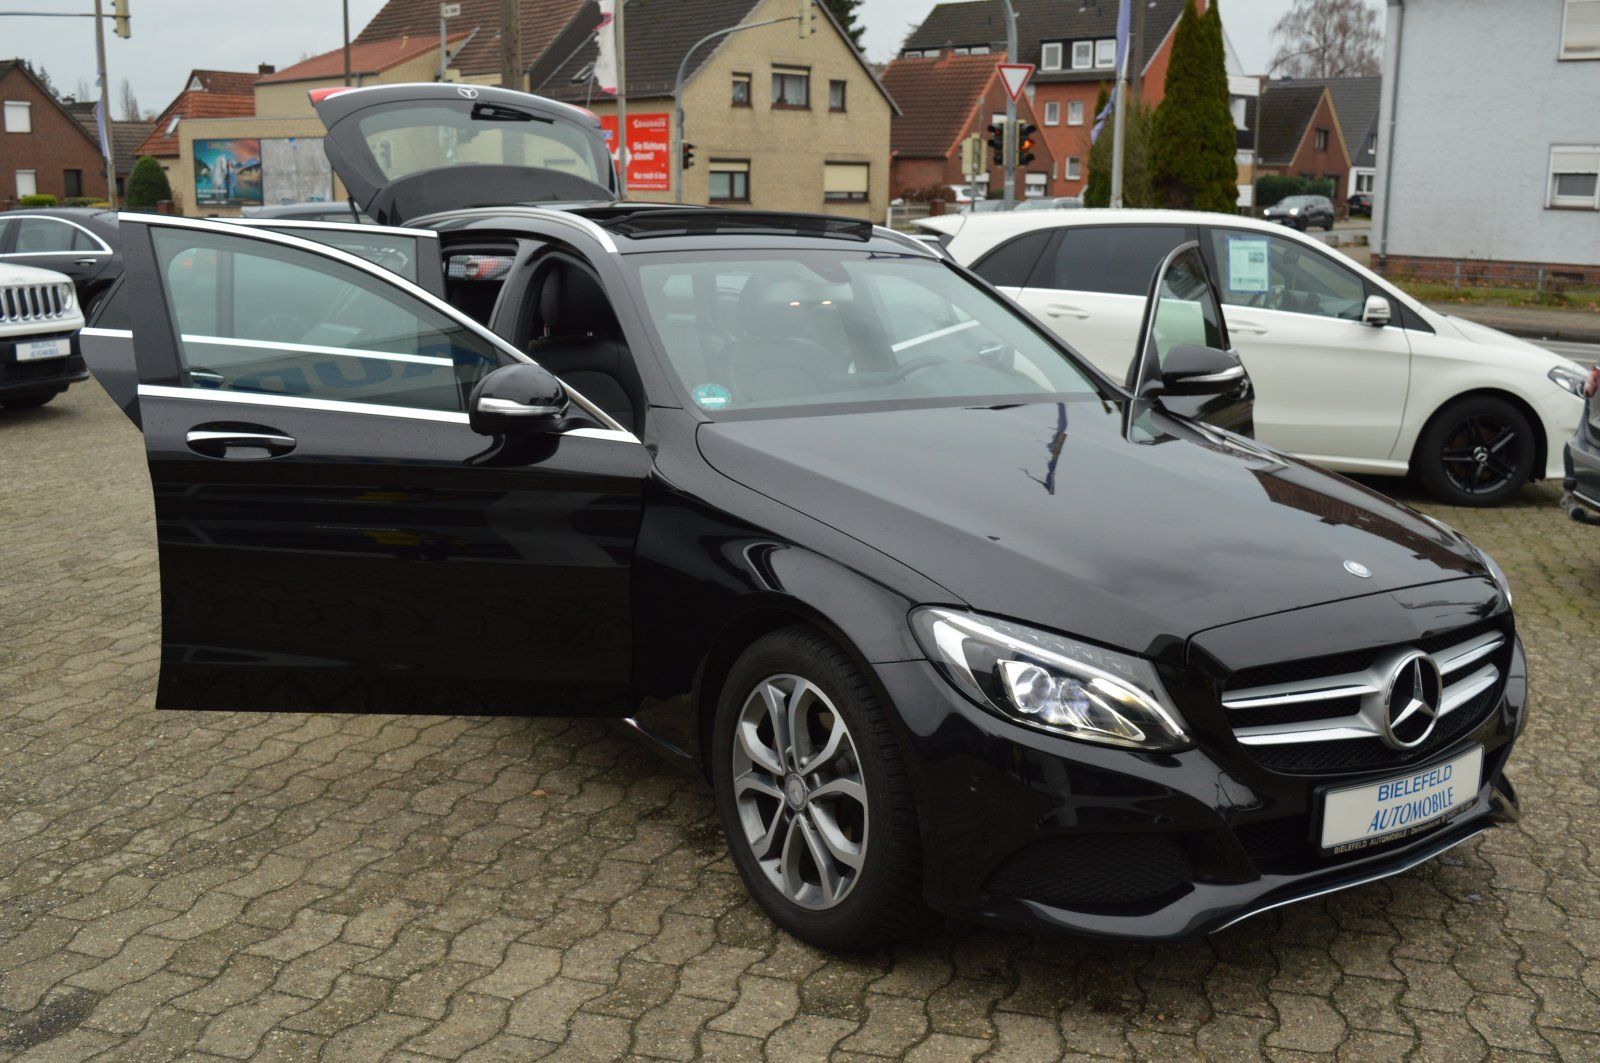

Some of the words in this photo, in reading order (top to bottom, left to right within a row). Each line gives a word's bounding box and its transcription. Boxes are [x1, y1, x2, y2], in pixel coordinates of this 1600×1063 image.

[1378, 764, 1452, 802] BIELEFELD
[1367, 786, 1453, 833] AUTOMOBILE
[1334, 840, 1367, 854] BIELEFELD
[1370, 830, 1407, 846] AUTOMOBILE
